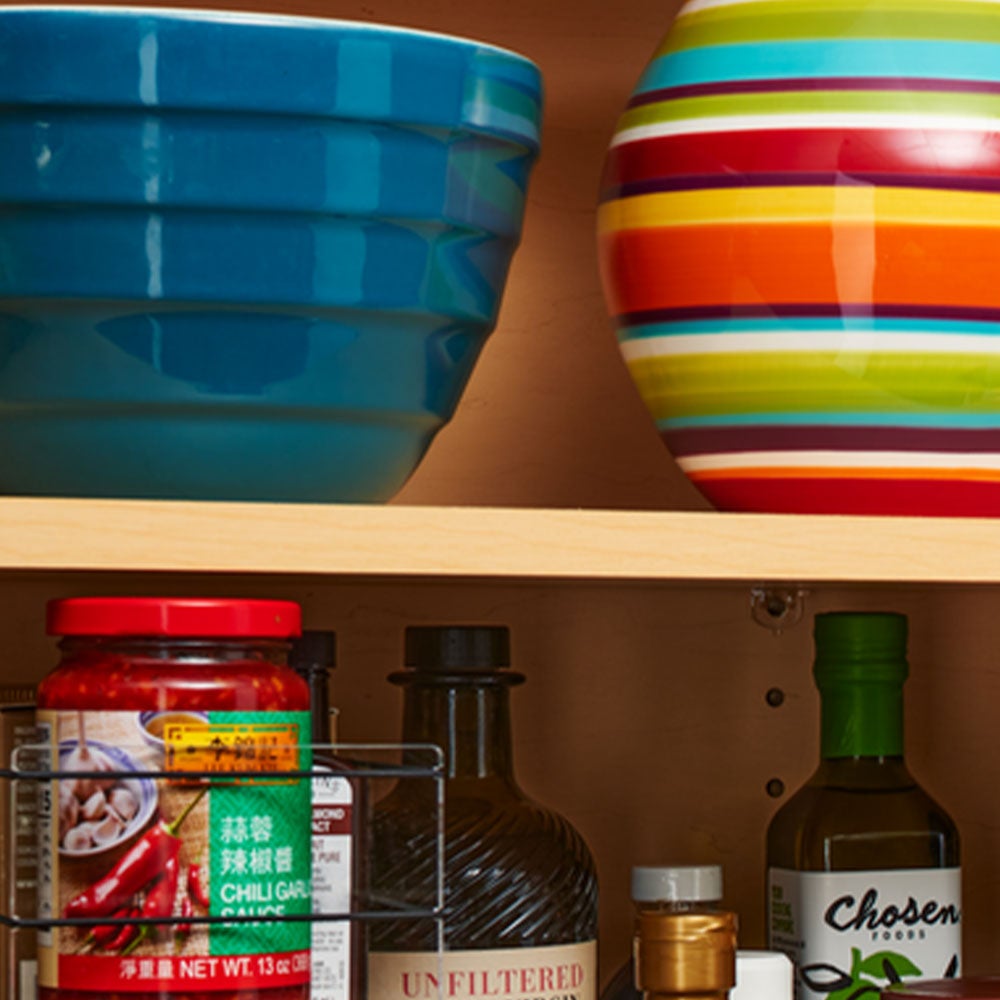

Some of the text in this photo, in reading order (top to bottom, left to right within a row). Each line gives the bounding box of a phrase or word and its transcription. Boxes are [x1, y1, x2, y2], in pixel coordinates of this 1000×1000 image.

[220, 882, 272, 904] CHILI
[824, 887, 961, 932] Chosen
[871, 930, 926, 941] FOODS
[180, 958, 218, 979] NET
[258, 956, 275, 976] 13
[276, 959, 291, 975] oz
[401, 962, 584, 998] UNFILTERED
